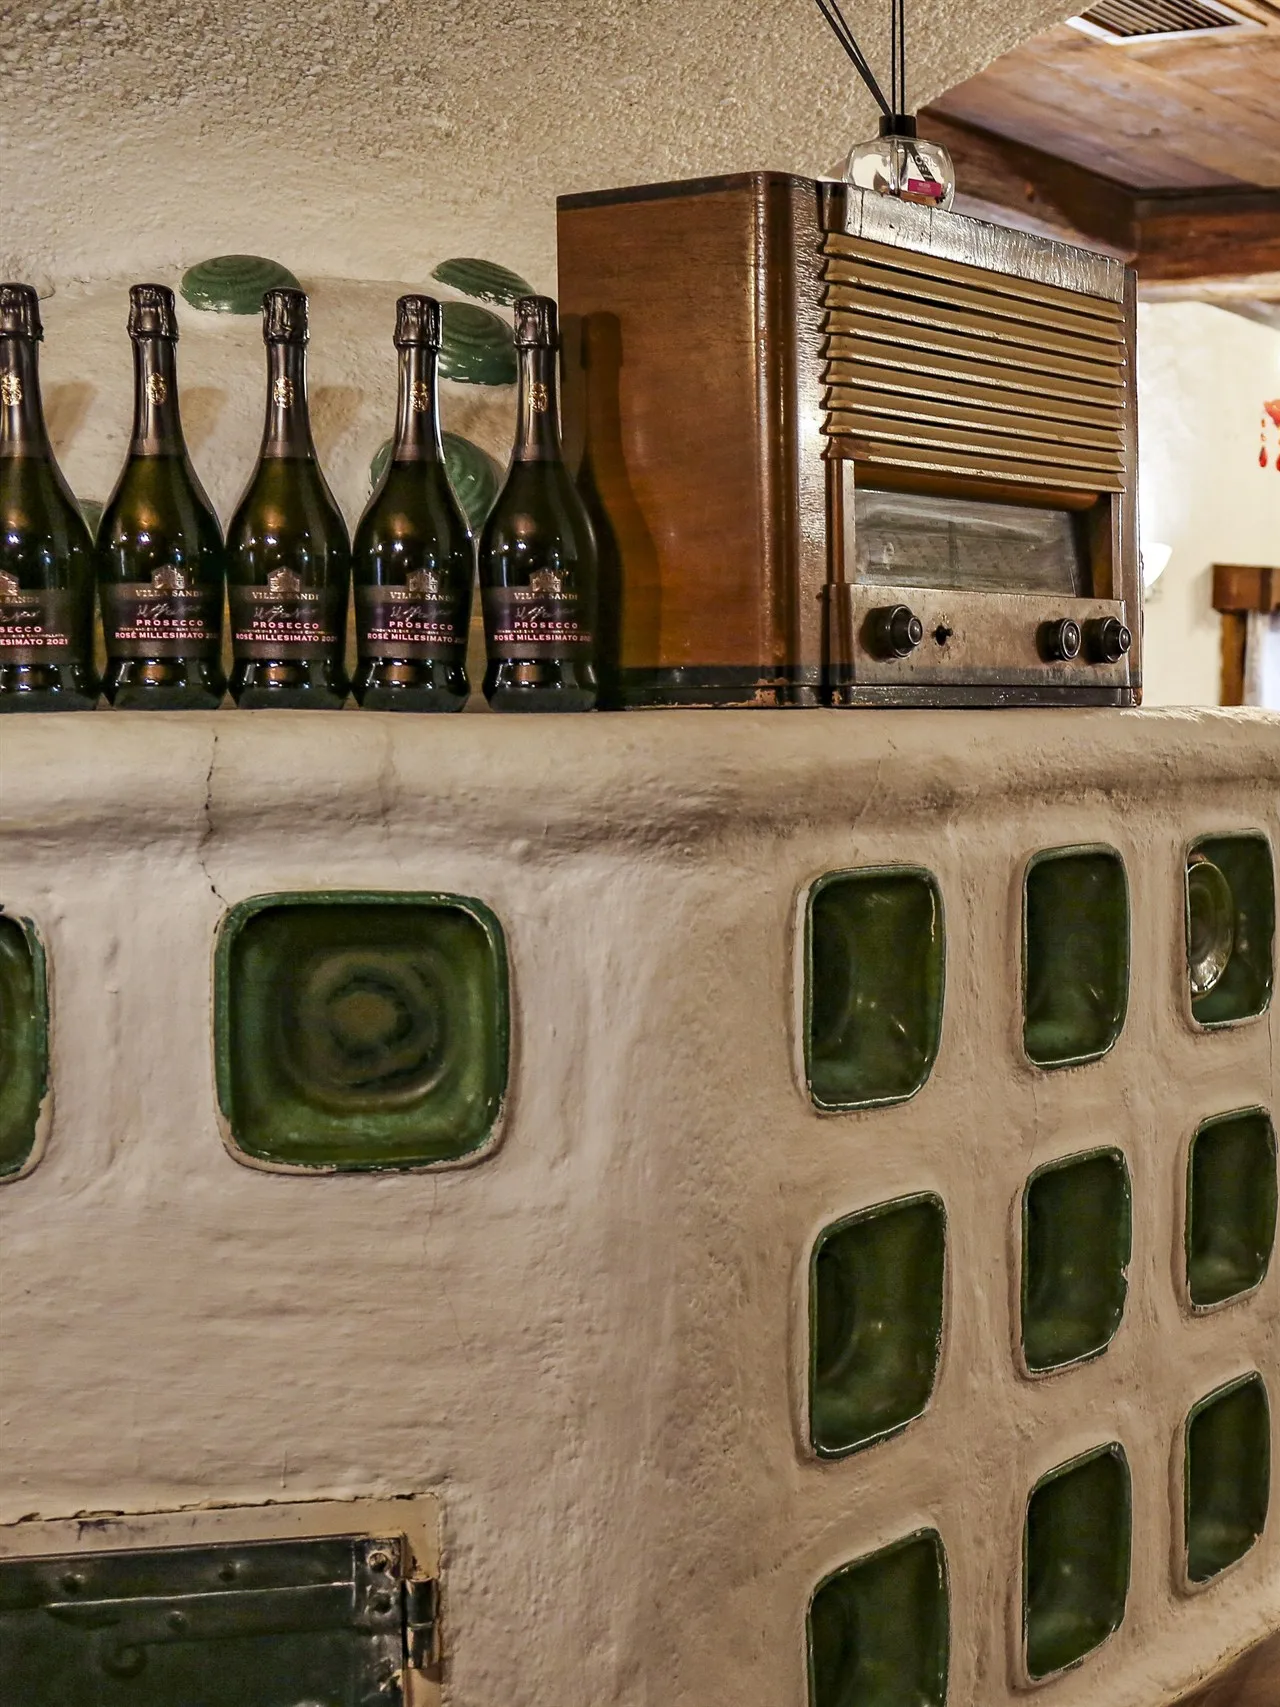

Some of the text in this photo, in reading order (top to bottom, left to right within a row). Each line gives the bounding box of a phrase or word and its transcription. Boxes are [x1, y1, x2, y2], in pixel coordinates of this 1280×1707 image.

[549, 593, 578, 601] SANDI
[136, 619, 204, 627] PROSECCO
[253, 622, 319, 630] PROSECCO
[389, 621, 454, 630] PROSECCO
[115, 631, 137, 639] ROSÉ
[236, 633, 254, 641] ROSÉ
[256, 634, 319, 642] MILLESIMATO
[368, 632, 389, 640] ROSÉ
[391, 634, 453, 643] MILLESIMATO
[494, 633, 515, 641] ROSÉ
